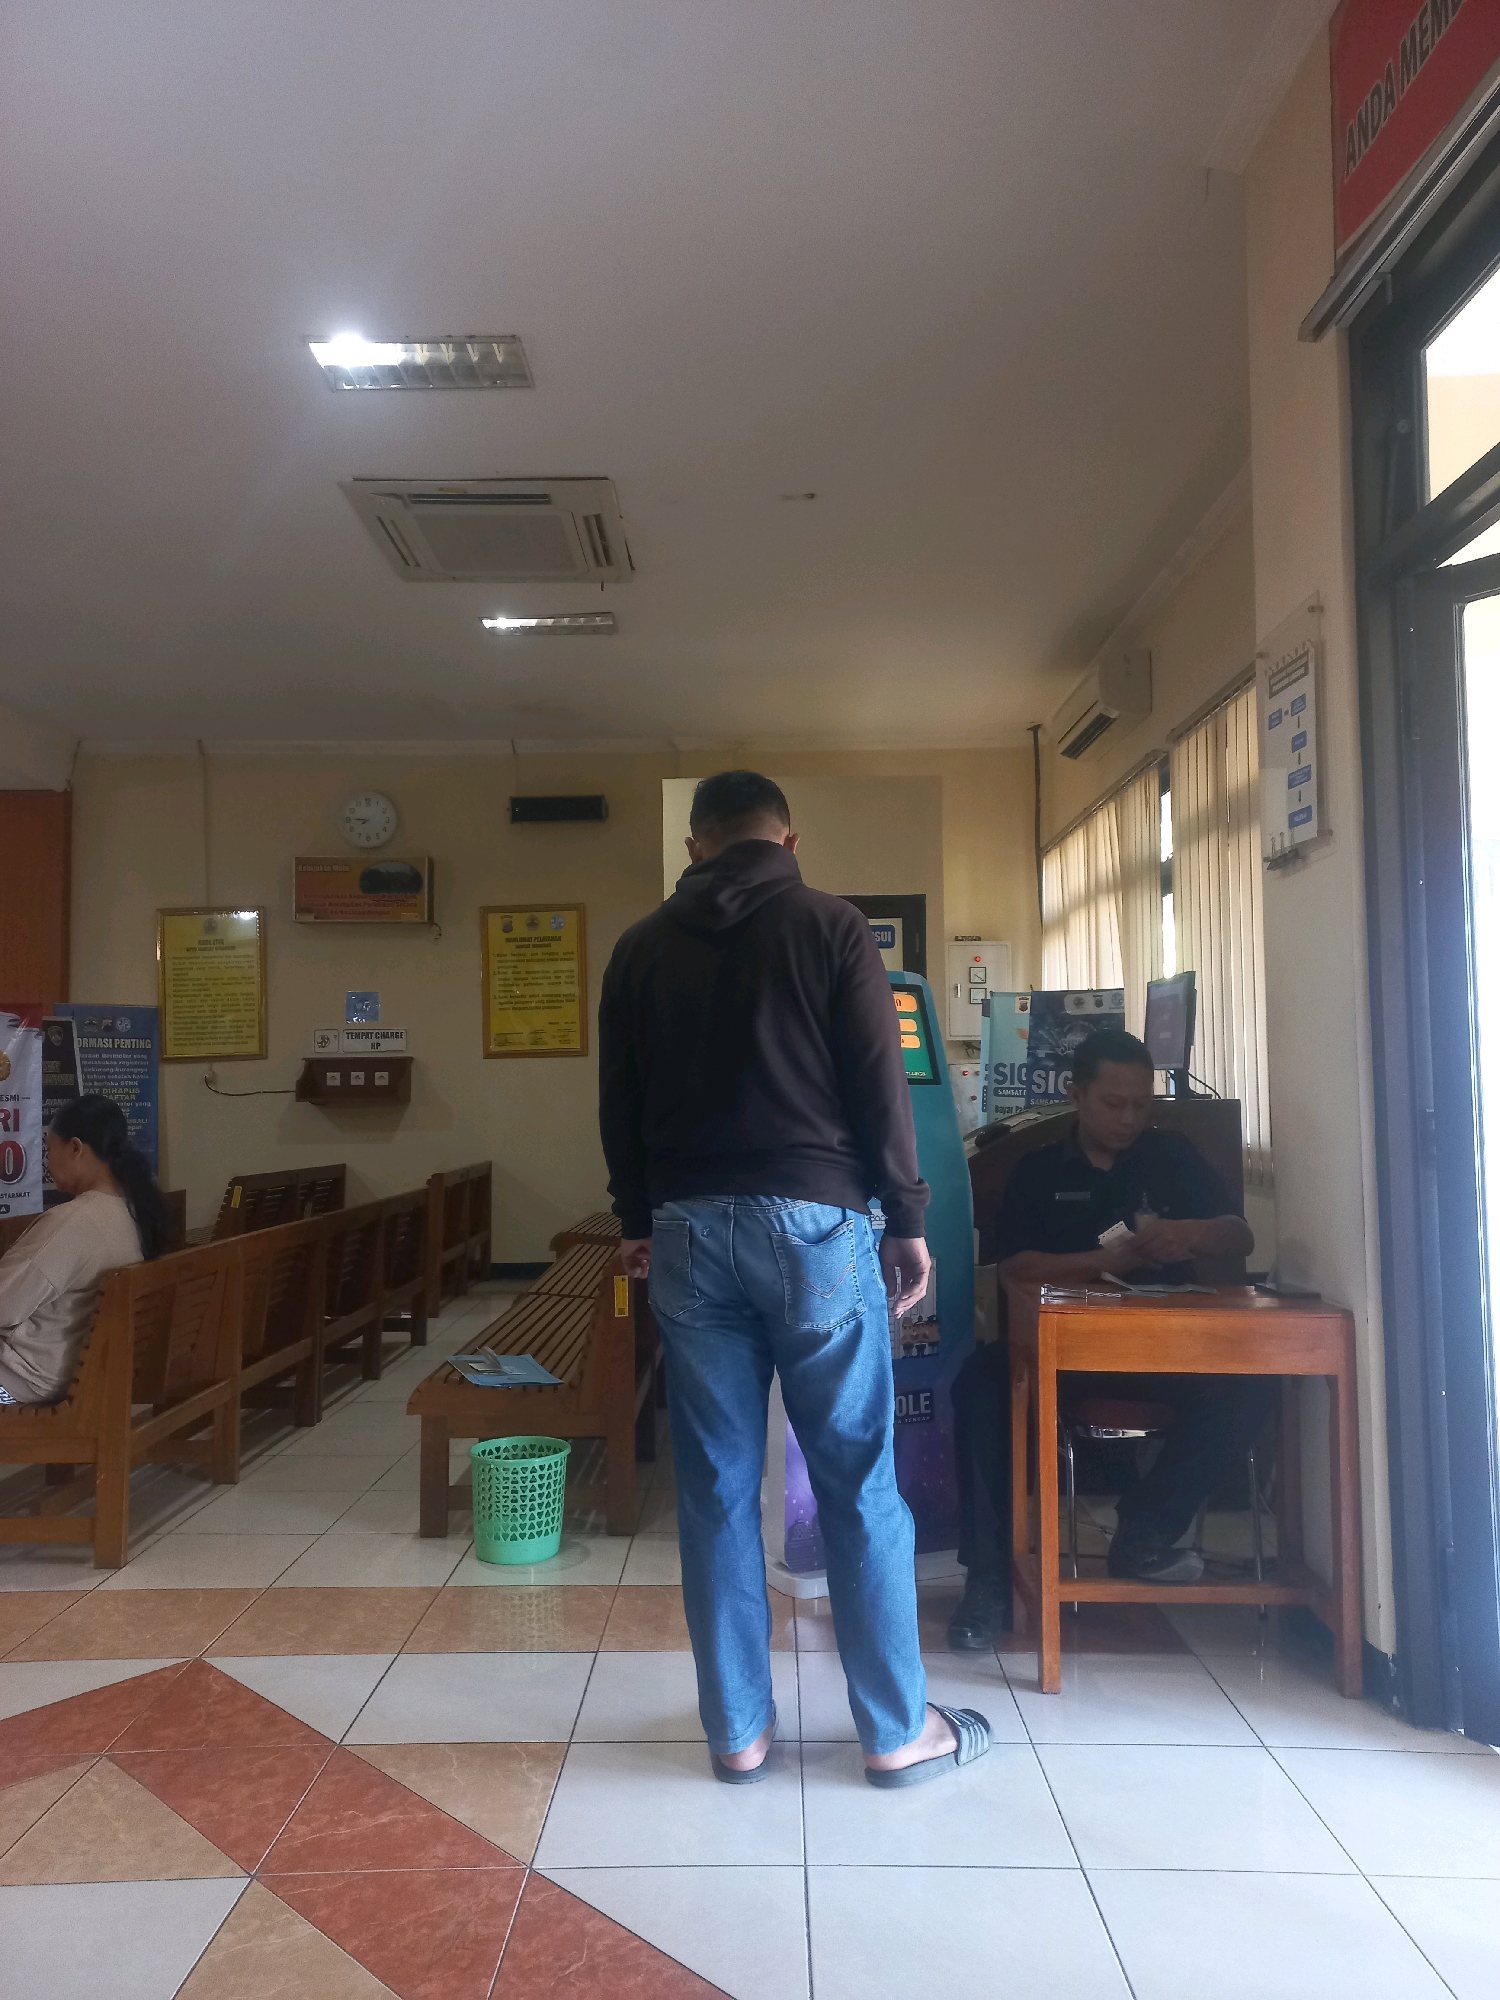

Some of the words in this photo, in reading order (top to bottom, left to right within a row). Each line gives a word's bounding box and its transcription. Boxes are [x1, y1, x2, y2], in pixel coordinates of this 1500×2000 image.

[1344, 57, 1397, 184] ANDA
[345, 1031, 374, 1040] TEMPAT
[374, 1031, 404, 1040] CHARGE
[114, 1038, 152, 1049] PENTING
[370, 1042, 381, 1050] HP
[102, 1087, 141, 1095] DIHAPUS
